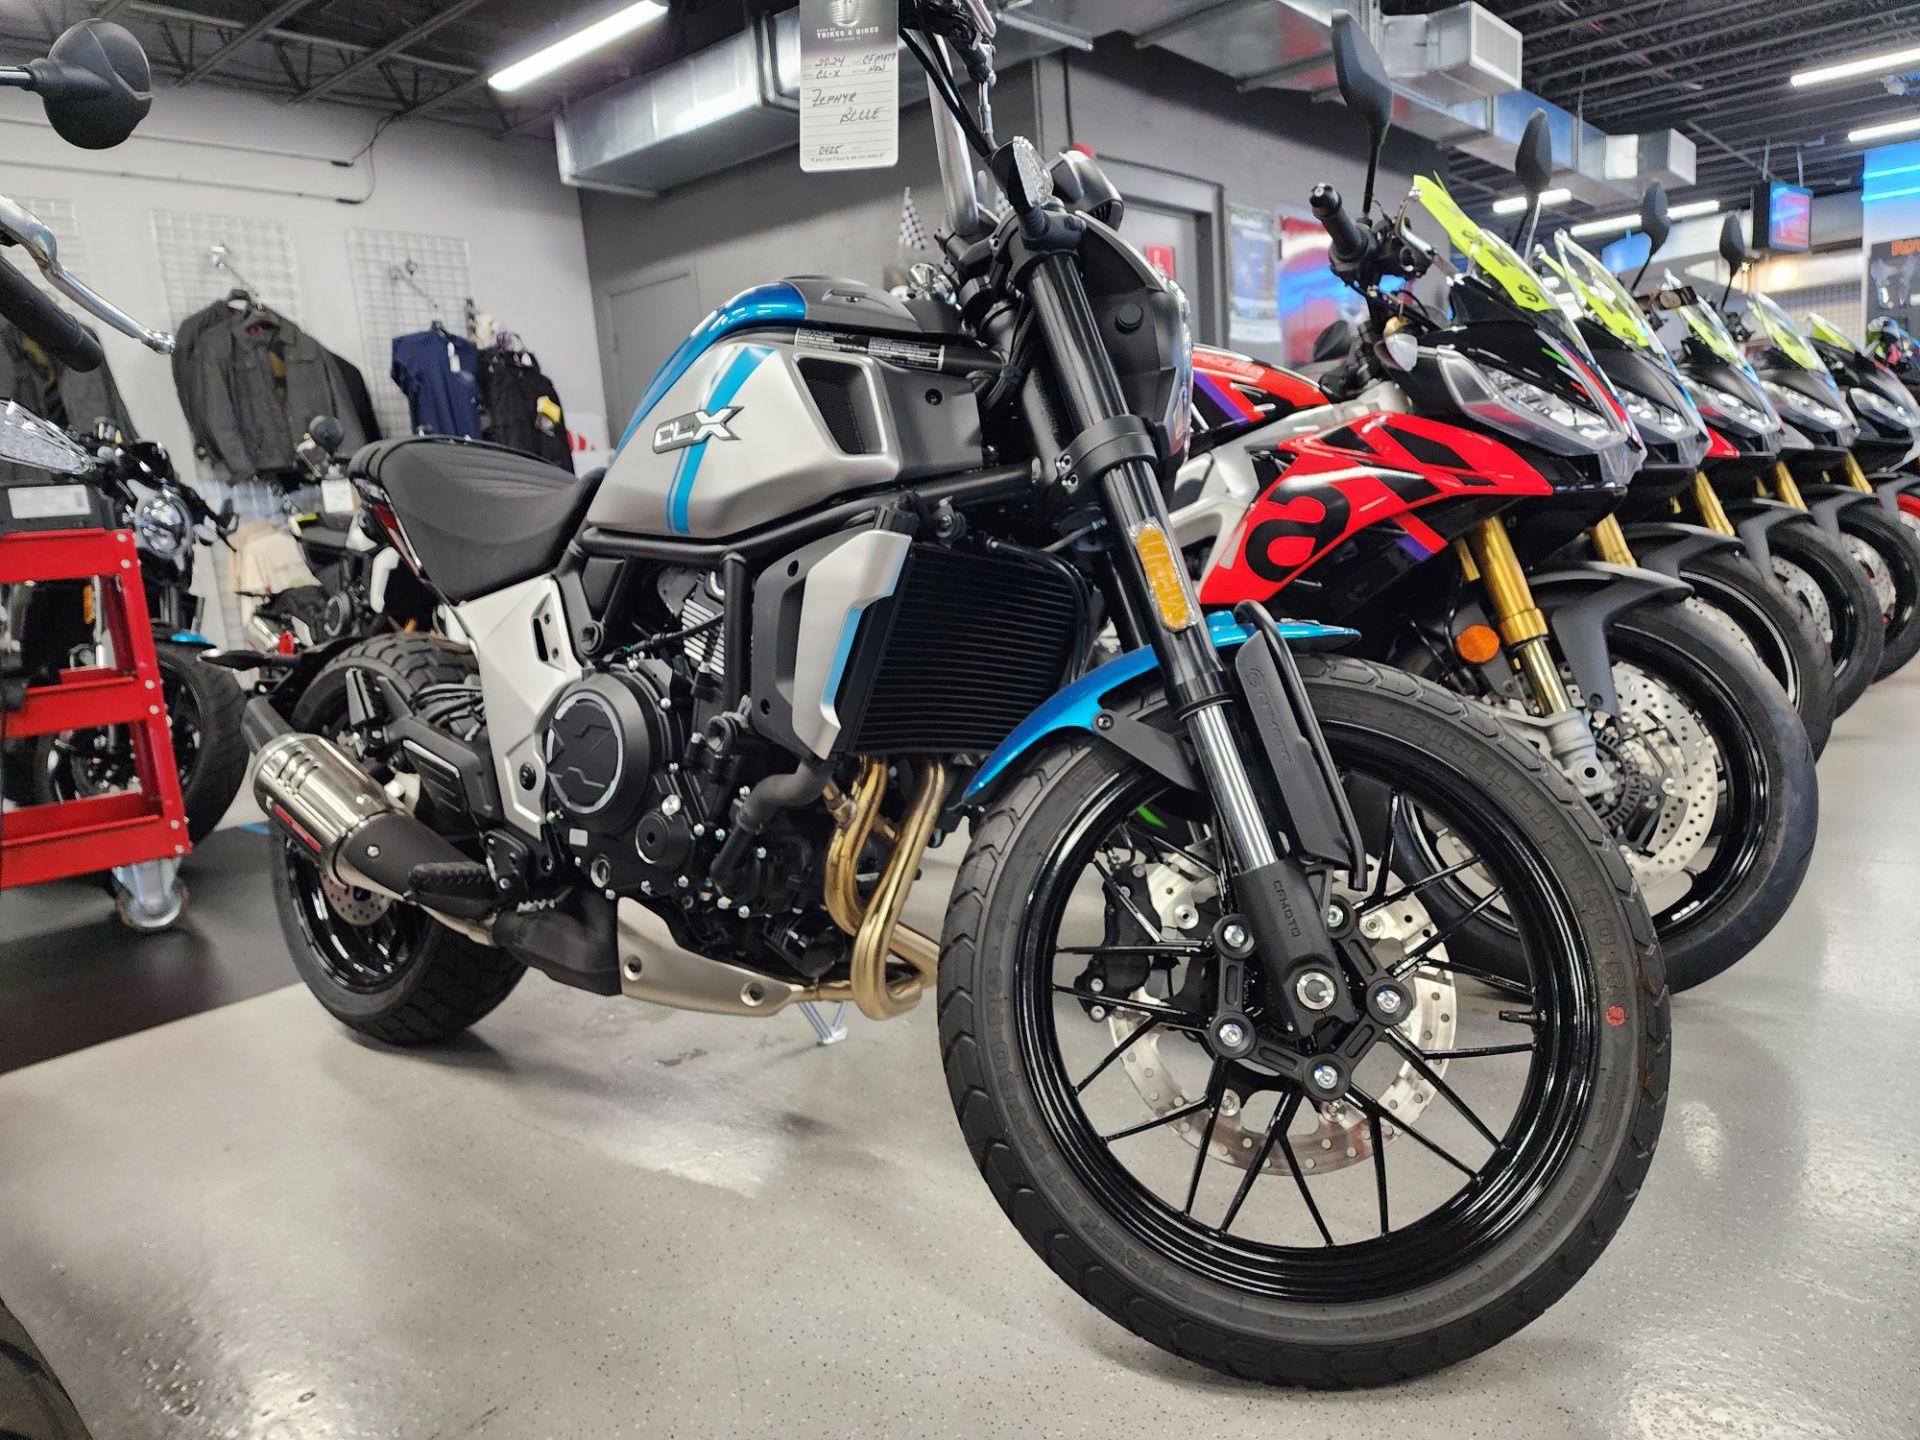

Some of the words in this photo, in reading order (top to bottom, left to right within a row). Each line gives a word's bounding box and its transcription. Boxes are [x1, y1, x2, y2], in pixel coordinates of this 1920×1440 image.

[816, 30, 845, 39] TRIKES
[855, 26, 879, 36] BIKES
[815, 55, 846, 67] 2024
[816, 69, 842, 80] CL-X
[839, 106, 884, 124] BLUE
[1404, 712, 1552, 826] PIRELLI
[1273, 880, 1301, 938] CFMOTO
